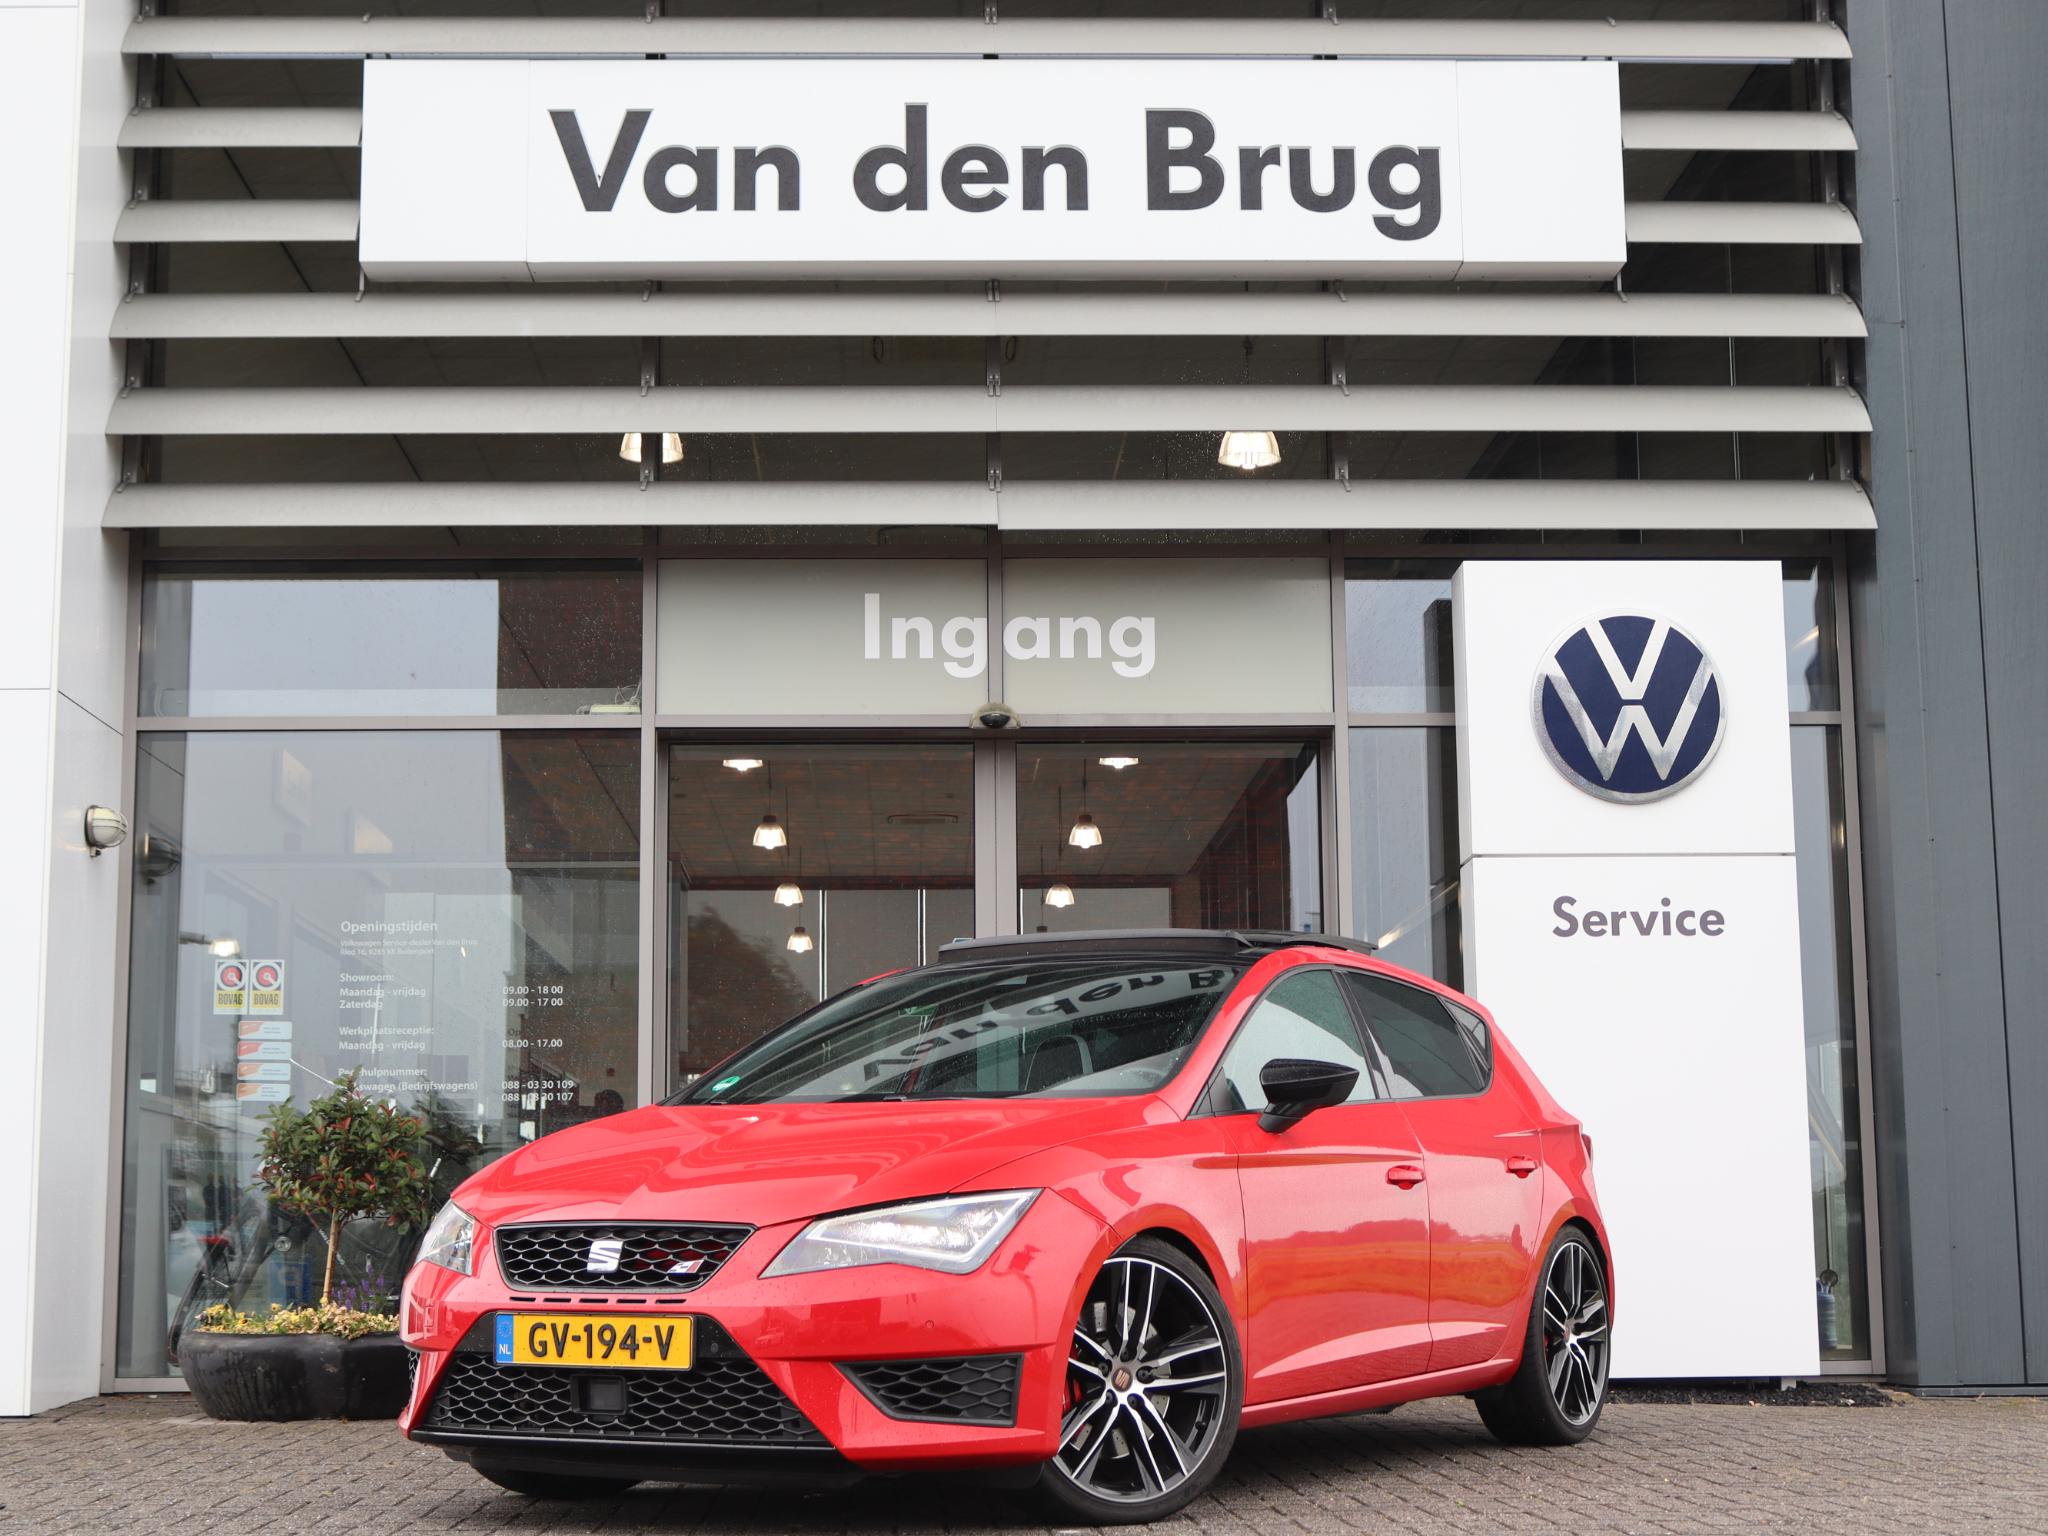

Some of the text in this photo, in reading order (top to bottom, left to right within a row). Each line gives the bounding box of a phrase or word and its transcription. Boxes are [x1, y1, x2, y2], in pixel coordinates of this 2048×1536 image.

[547, 102, 1442, 242] Van den Brug
[864, 592, 1157, 679] Ingang
[1552, 895, 1726, 938] Service
[340, 920, 438, 935] Openingstijden
[339, 973, 395, 982] Showroom:
[339, 987, 385, 998] Maandag
[392, 987, 426, 998] vrijdag
[502, 986, 529, 995] 09.00
[217, 993, 244, 1006] BOVAG
[339, 999, 384, 1010] Zaterdag
[502, 998, 529, 1007] 09.00
[338, 1041, 384, 1051] Maandag
[392, 1040, 426, 1051] vrijdag
[502, 1039, 529, 1048] 08.00
[537, 1039, 563, 1048] 17.00
[398, 1080, 478, 1092] (Bedrijfswagens)
[501, 1080, 520, 1089] 088
[527, 1080, 540, 1089] 03
[541, 1080, 554, 1089] 30
[556, 1080, 574, 1088] 109
[501, 1093, 520, 1101] 088
[556, 1092, 573, 1101] 107
[528, 1321, 675, 1361] GV-194-V
[499, 1343, 512, 1356] NL
